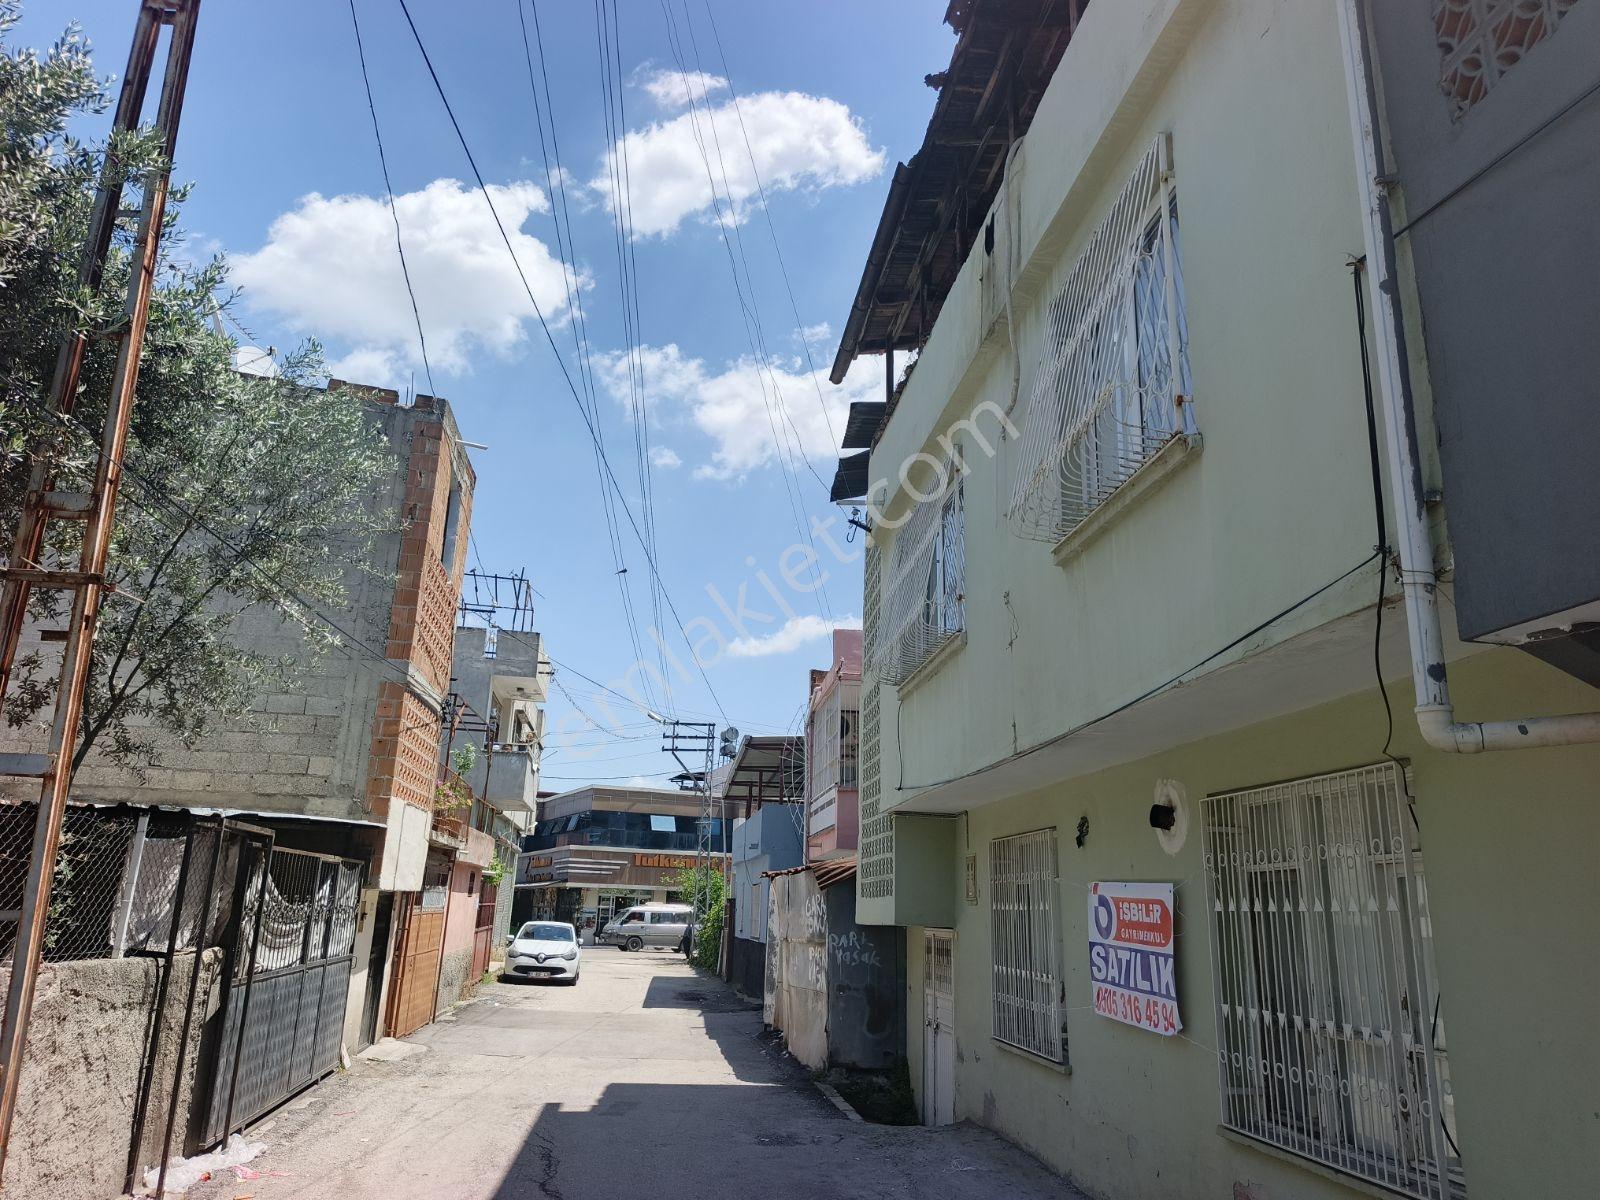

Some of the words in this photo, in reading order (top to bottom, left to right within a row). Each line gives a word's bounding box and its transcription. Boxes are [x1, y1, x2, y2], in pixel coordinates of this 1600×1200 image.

[1119, 902, 1161, 923] İŞBİLİR
[1092, 945, 1175, 996] SATILIK
[1095, 986, 1118, 1016] 0505
[1120, 993, 1142, 1024] 316
[1145, 998, 1160, 1029] 45
[1161, 1002, 1176, 1033] 94
